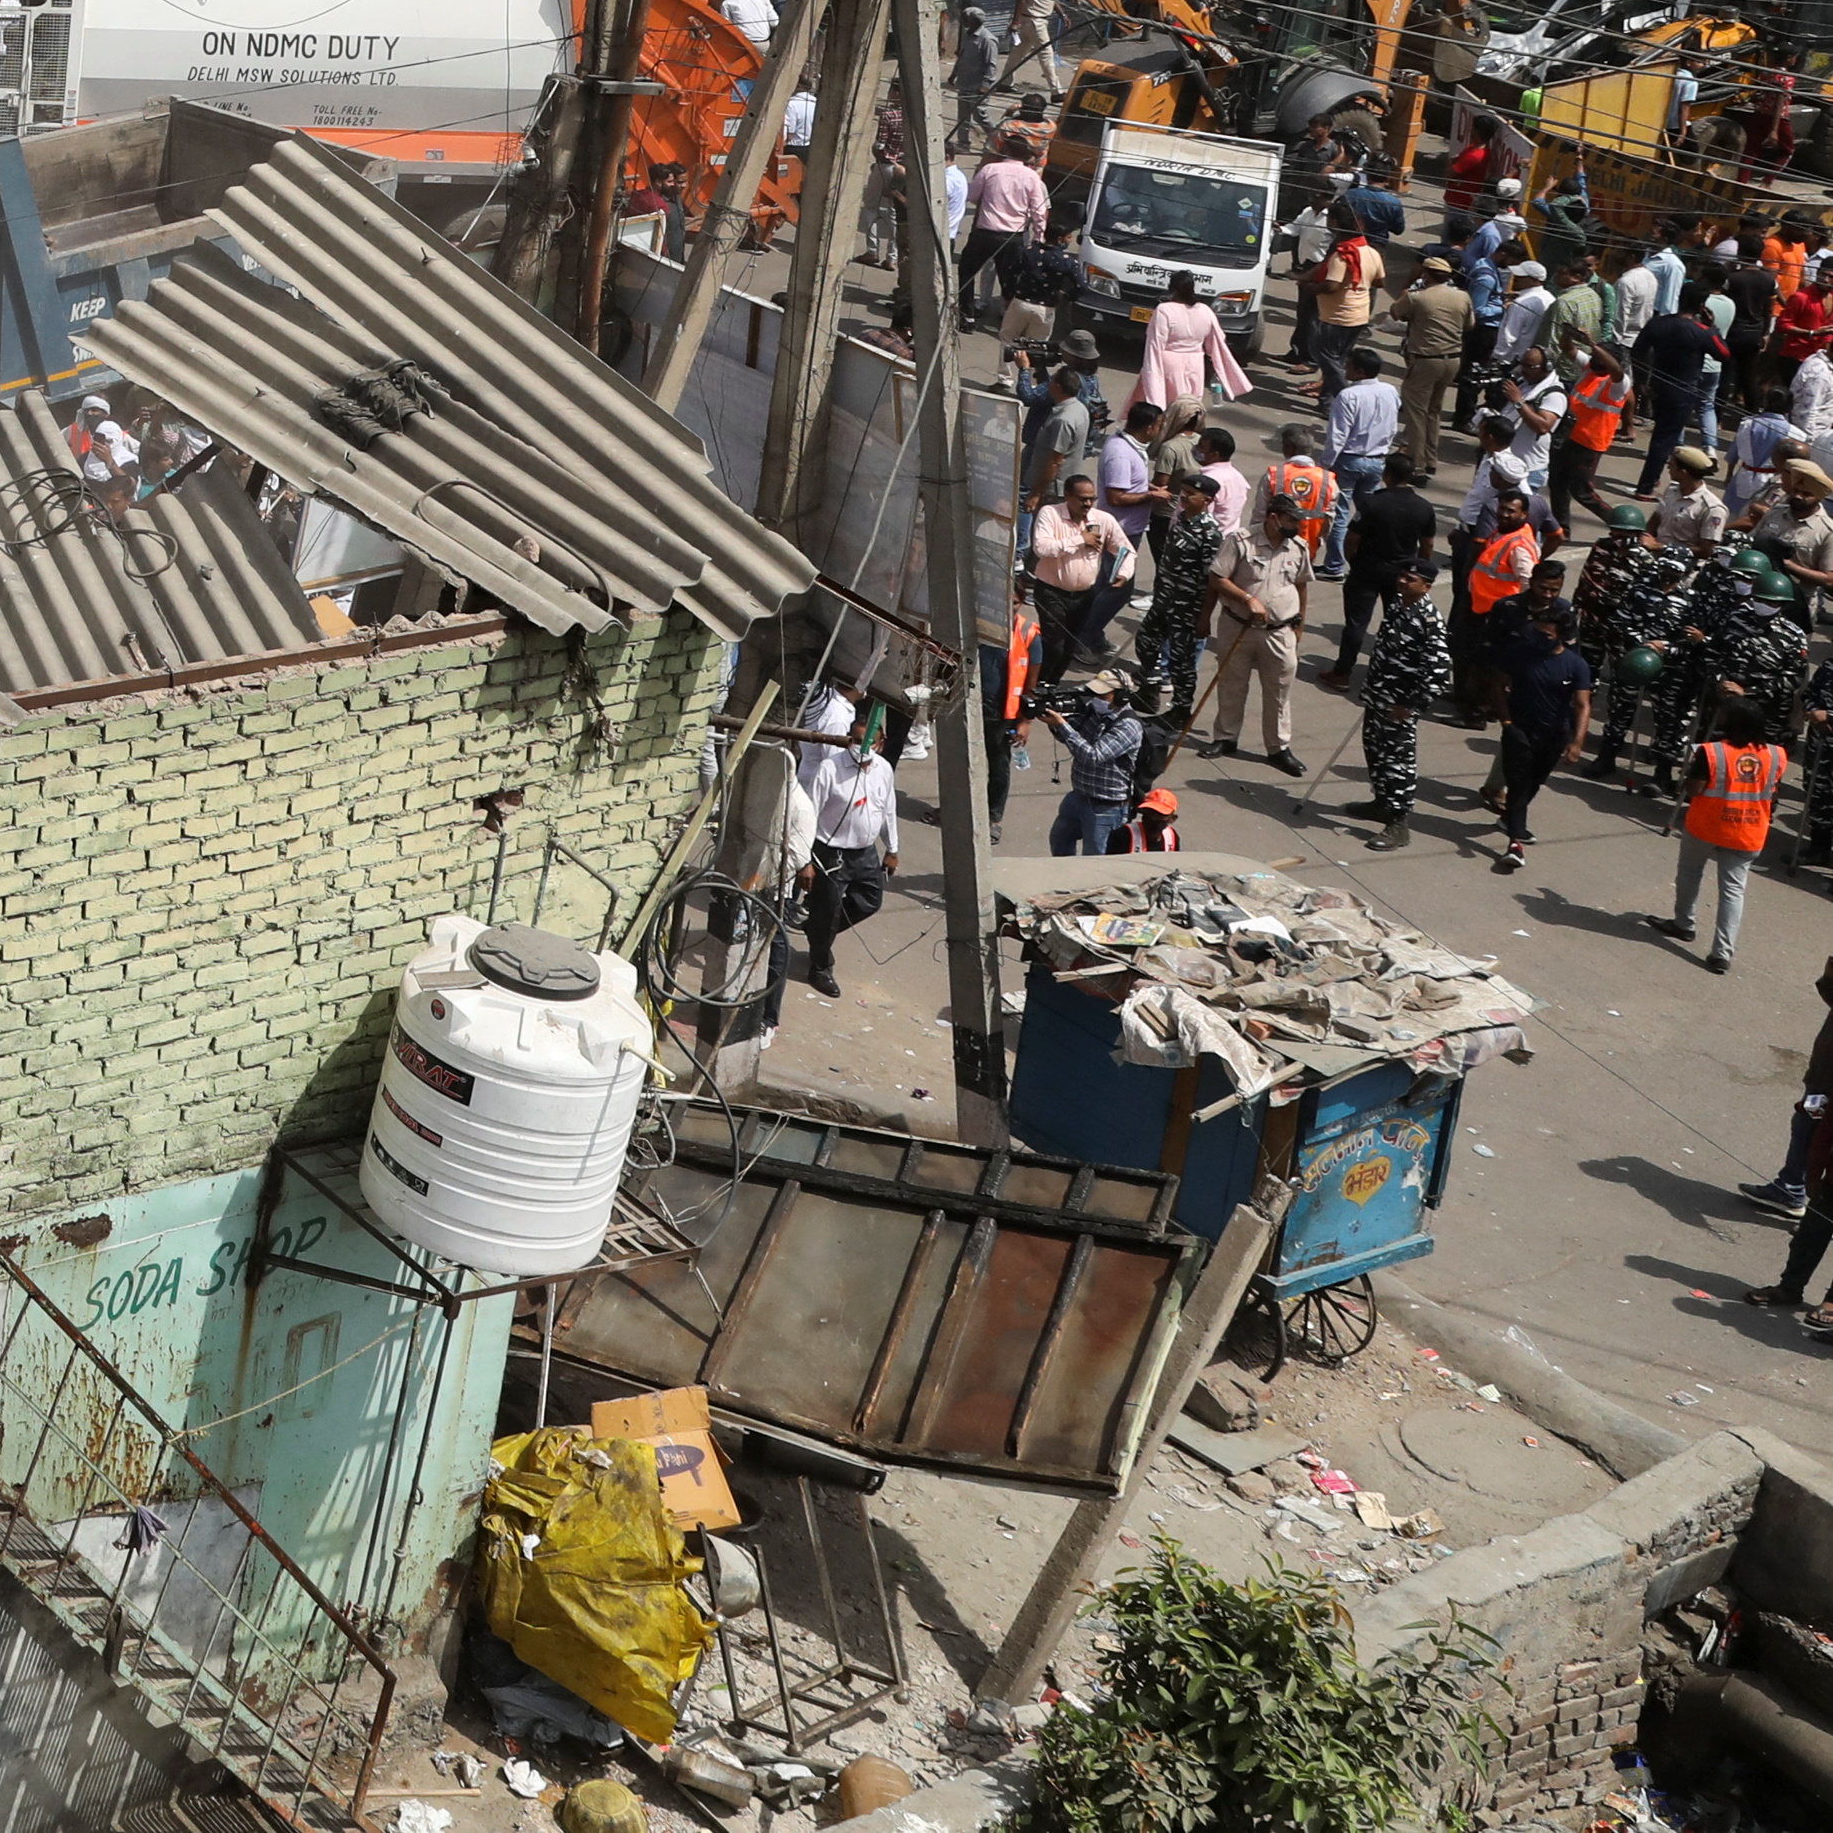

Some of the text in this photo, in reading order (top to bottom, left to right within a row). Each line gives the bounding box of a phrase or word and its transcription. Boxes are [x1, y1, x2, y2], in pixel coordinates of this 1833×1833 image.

[203, 32, 400, 60] ON NDMC DUTY
[187, 66, 399, 86] DELHI MSW SOLUTIONS LTD.
[313, 104, 363, 115] TOLL FREE
[313, 116, 374, 126] 1800114243
[70, 297, 106, 323] KEEP
[78, 1257, 183, 1332] SODA
